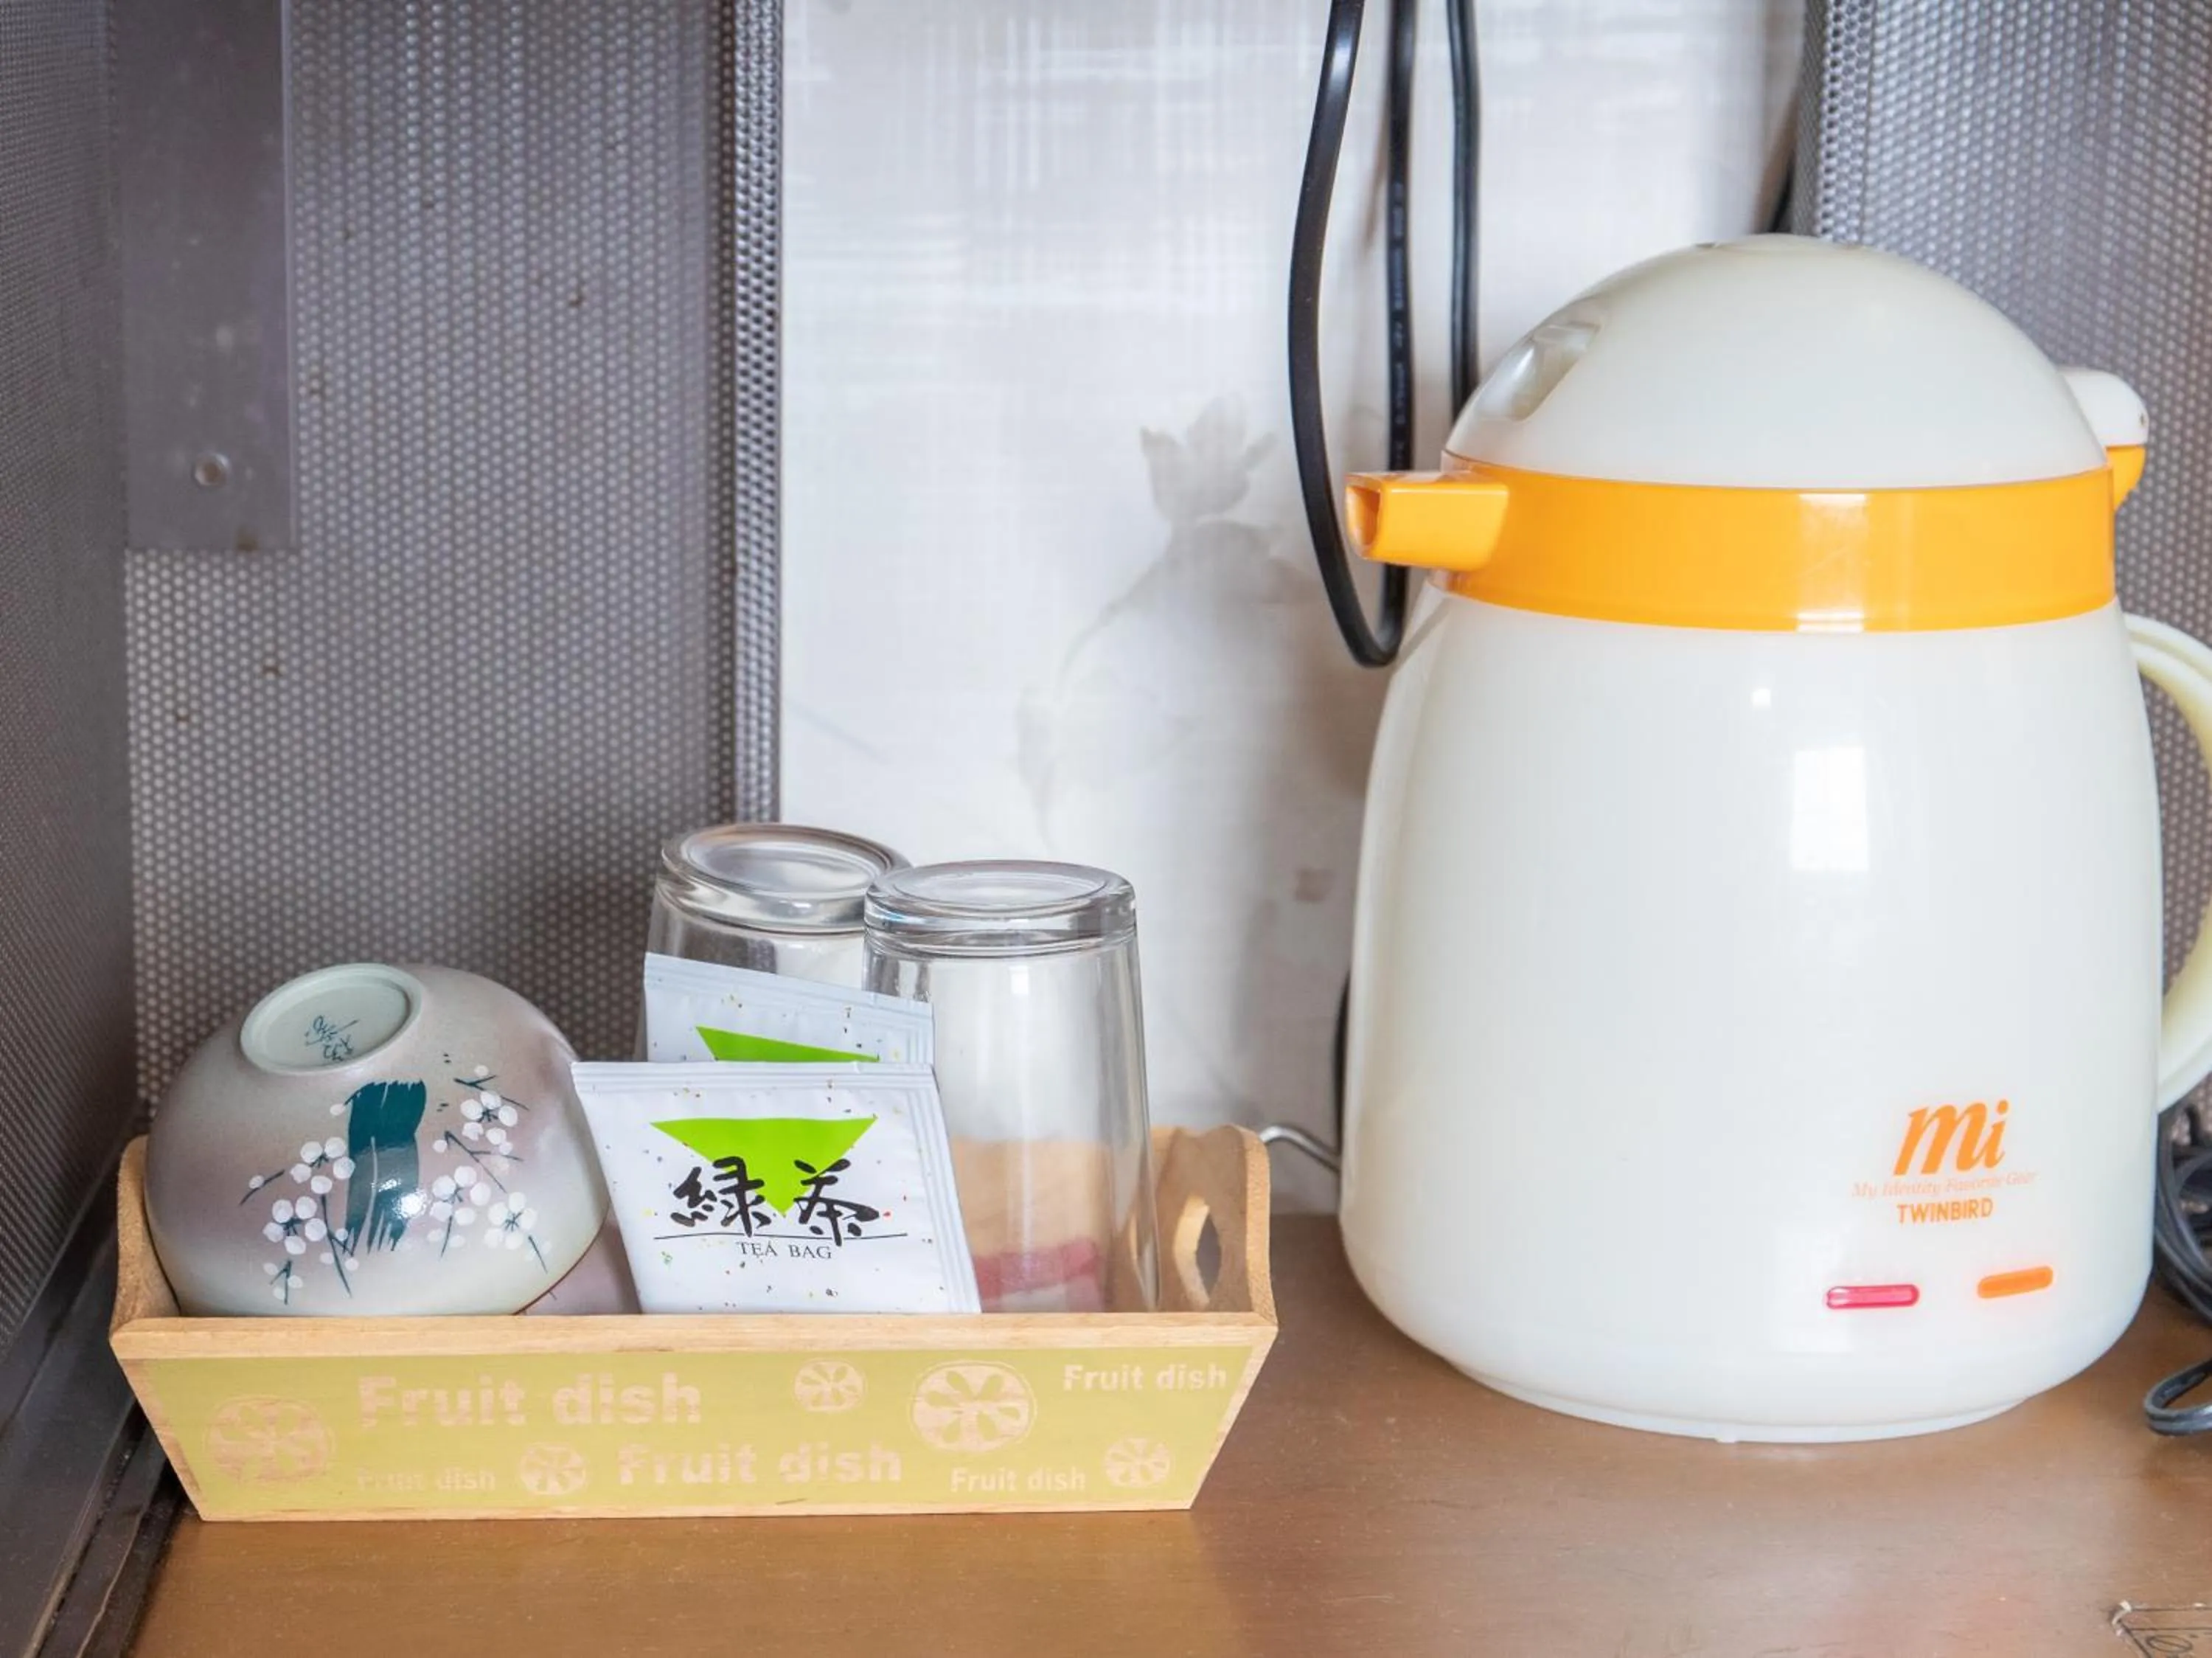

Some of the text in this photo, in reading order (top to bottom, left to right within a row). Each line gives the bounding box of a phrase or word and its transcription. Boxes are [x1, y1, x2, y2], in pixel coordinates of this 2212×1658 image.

[669, 1156, 880, 1246] 緑茶
[1896, 1198, 1994, 1224] TWINBIRD
[736, 1240, 832, 1259] TEA BAG
[1062, 1364, 1227, 1391] Fruit dish
[357, 1371, 703, 1427] Fruit dish
[619, 1442, 902, 1485] Fruit dish
[950, 1466, 1086, 1493] Fruit dish
